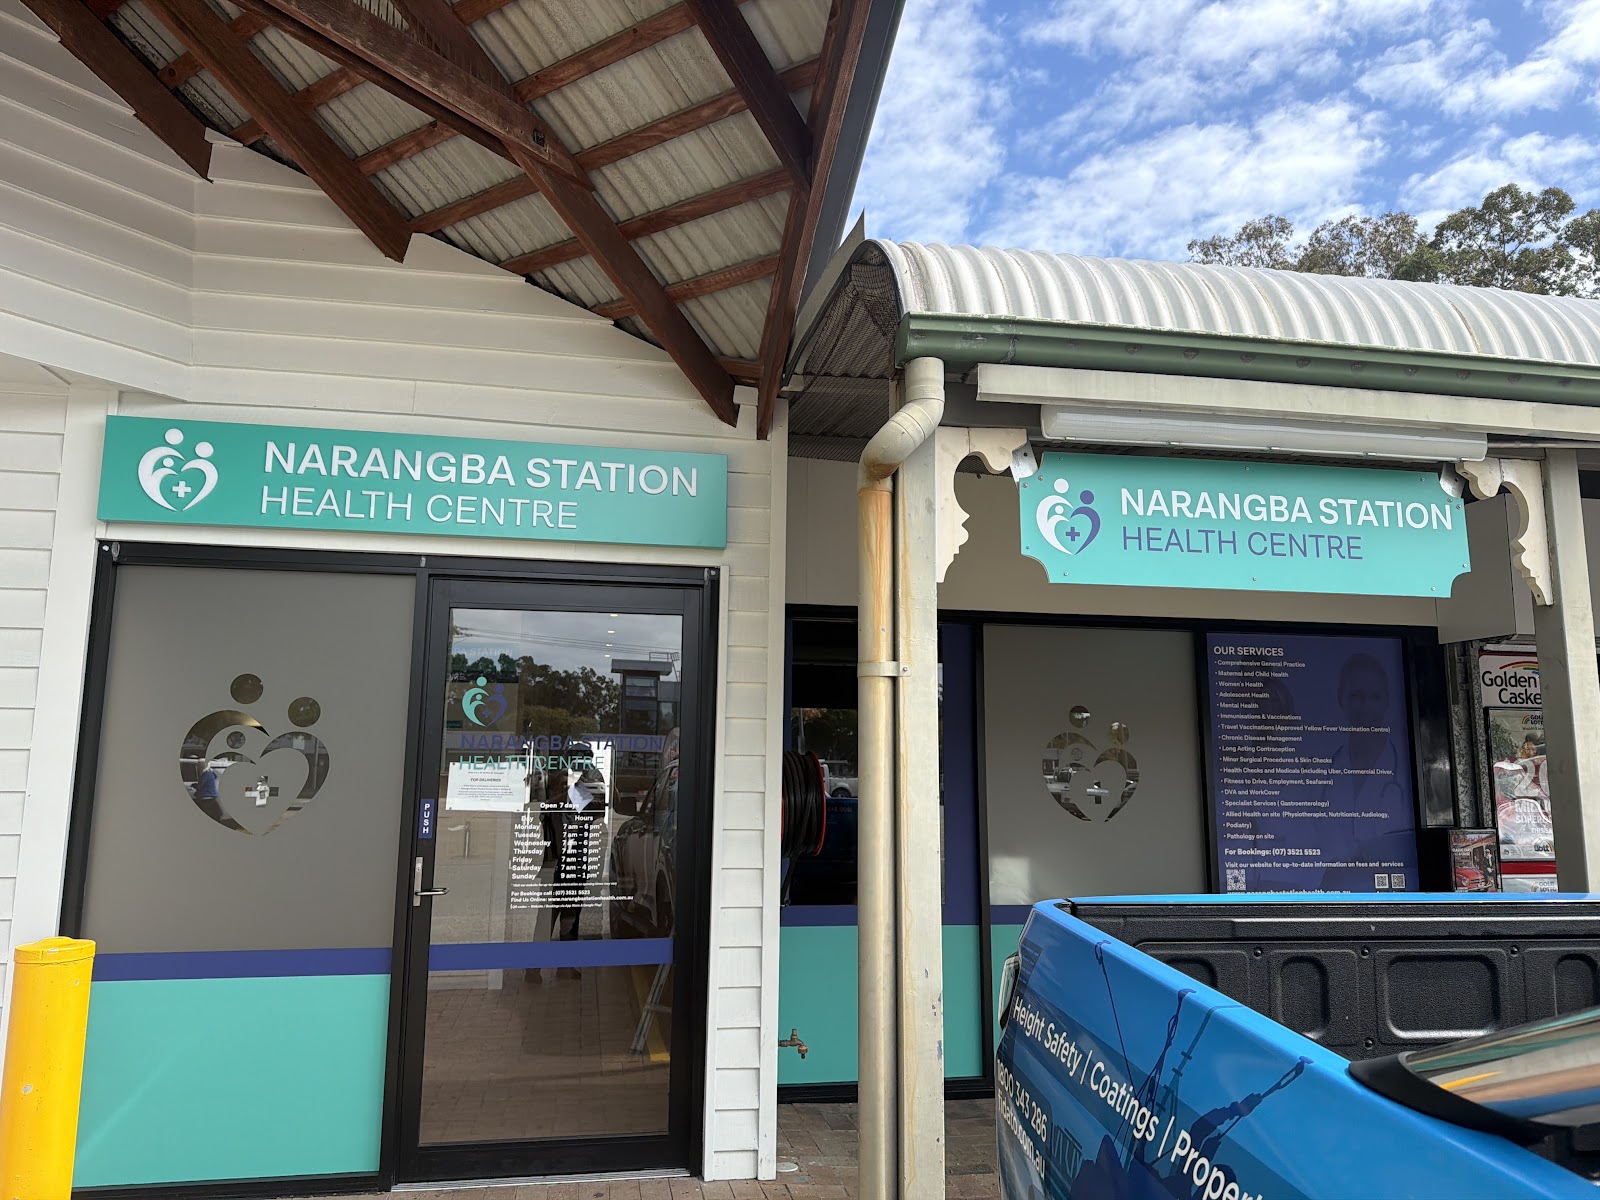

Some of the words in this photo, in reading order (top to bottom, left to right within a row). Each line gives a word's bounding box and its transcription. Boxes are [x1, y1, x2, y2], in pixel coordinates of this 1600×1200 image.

[264, 441, 516, 487] NARANGBA
[526, 458, 698, 497] STATION
[262, 487, 411, 521] HEALTH
[427, 494, 578, 529] CENTRE
[1121, 488, 1312, 524] NARANGBA
[1319, 498, 1453, 530] STATION
[1123, 526, 1237, 555] HEALTH
[1248, 532, 1363, 560] CENTRE
[1214, 646, 1235, 655] OUR
[1237, 647, 1284, 656] SERVICES
[1482, 671, 1537, 688] Golden
[1498, 688, 1542, 704] Caske
[1275, 724, 1303, 732] (Approved
[461, 734, 575, 750] NARANGBA
[579, 735, 662, 750] STATION
[459, 755, 529, 770] HEALTH
[535, 755, 604, 770] CENTRE
[564, 802, 579, 810] days
[422, 803, 430, 834] PUSH
[521, 815, 534, 823] Day
[512, 856, 533, 864] Friday
[1238, 849, 1271, 857] Bookings:
[1272, 848, 1286, 856] (07)
[997, 1059, 1014, 1099] 1800
[1015, 1079, 1030, 1120] 343
[1031, 1101, 1048, 1143] 286
[1013, 996, 1045, 1042] Height
[1044, 1023, 1083, 1077] Safety
[1090, 1061, 1160, 1142] Coatings
[1171, 1129, 1263, 1200] Prope
